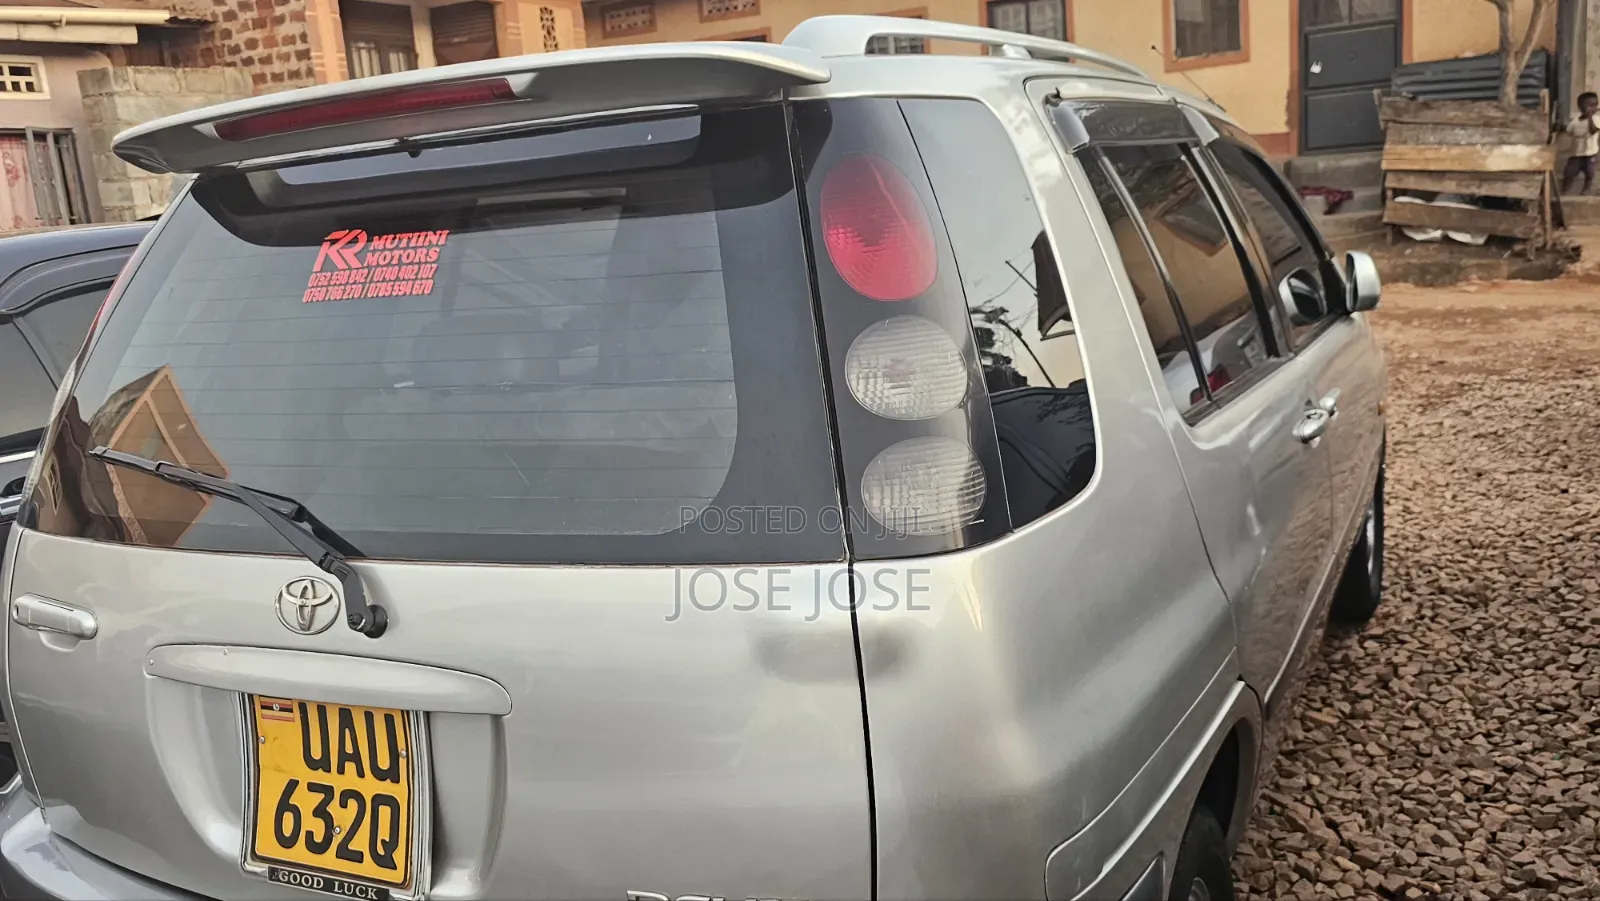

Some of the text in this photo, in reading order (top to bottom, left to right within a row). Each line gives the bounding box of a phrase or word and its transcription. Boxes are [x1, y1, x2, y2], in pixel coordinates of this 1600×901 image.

[369, 230, 450, 250] MUTIINI
[363, 246, 440, 267] MOTORS
[308, 272, 331, 287] 0752
[373, 266, 400, 281] 0740
[398, 265, 419, 280] 402
[418, 263, 438, 279] 107
[302, 287, 326, 303] 0750
[342, 284, 363, 299] 270
[392, 281, 413, 296] 594
[412, 279, 433, 295] 670
[298, 701, 400, 784] UAU
[274, 778, 400, 870] 632Q
[279, 870, 378, 900] GOOD LUCK
